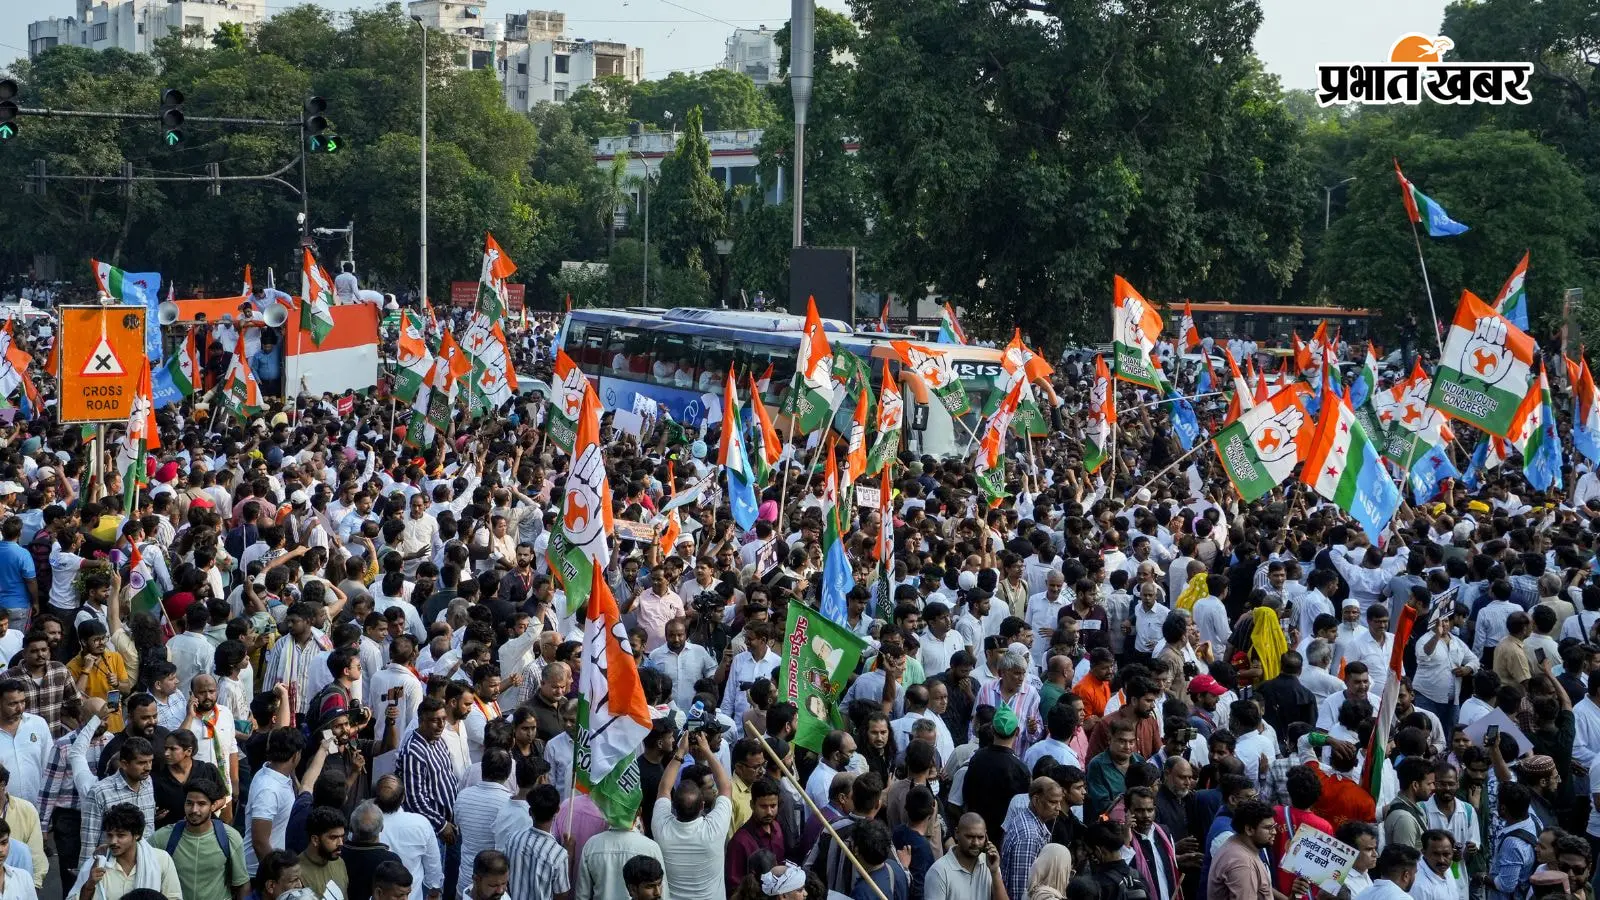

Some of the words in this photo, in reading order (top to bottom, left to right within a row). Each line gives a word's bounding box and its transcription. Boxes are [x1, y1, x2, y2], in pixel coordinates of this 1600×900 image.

[83, 386, 123, 397] CROSS
[86, 400, 119, 410] ROAD
[1441, 380, 1473, 400] INDIAN
[1472, 391, 1498, 412] YOUTH
[1443, 394, 1488, 418] CONGRESS
[1225, 445, 1247, 481] CONGRESS
[1230, 434, 1246, 460] INDIAN
[1242, 457, 1259, 481] YOUTH
[1299, 836, 1320, 853] लोकतंत्र
[1320, 843, 1332, 858] की
[1330, 851, 1348, 867] हत्या
[1304, 849, 1316, 862] बंद
[1314, 855, 1330, 869] करो
